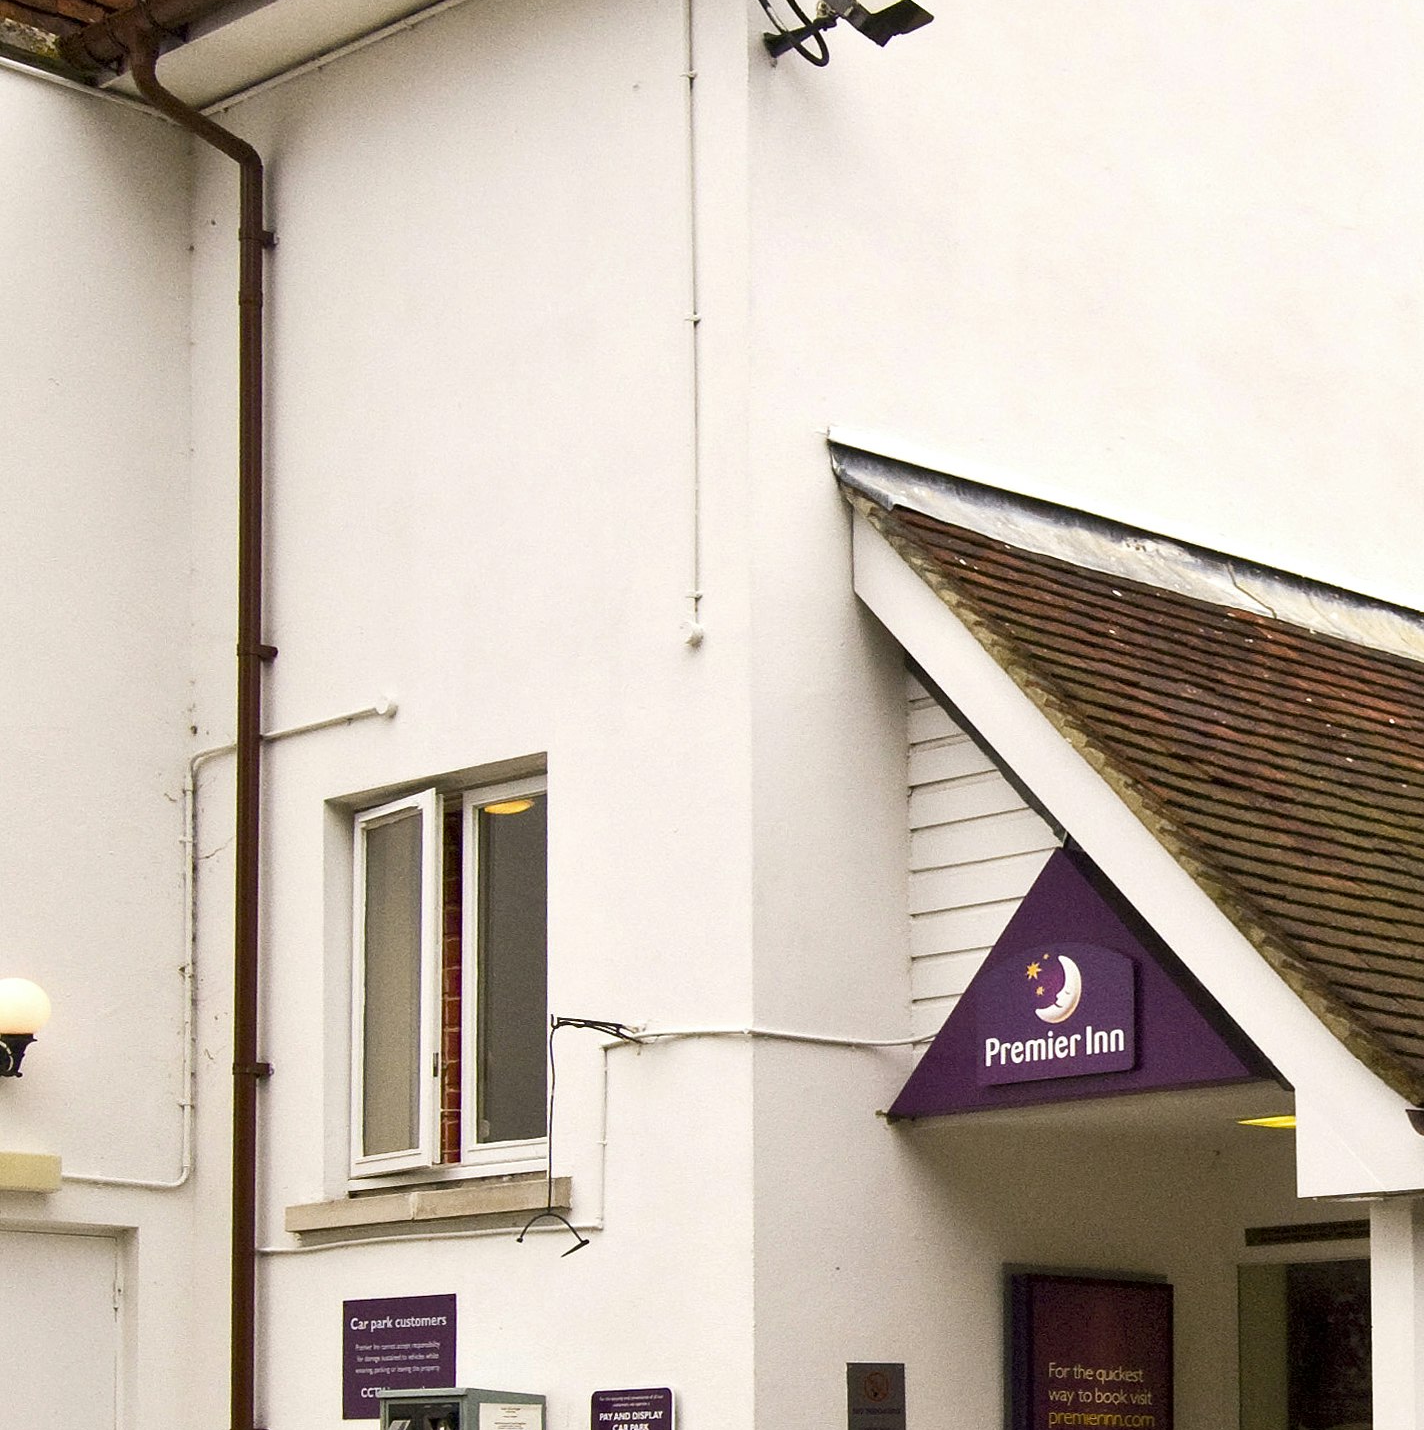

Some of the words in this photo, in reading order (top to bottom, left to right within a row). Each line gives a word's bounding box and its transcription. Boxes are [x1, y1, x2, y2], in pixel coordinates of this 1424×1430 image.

[985, 1030, 1082, 1067] Premier
[1085, 1025, 1125, 1056] Inn
[350, 1317, 369, 1331] Car
[370, 1316, 393, 1333] park
[394, 1316, 448, 1328] customers
[1048, 1362, 1071, 1379] For
[1072, 1364, 1094, 1380] the
[1095, 1366, 1144, 1384] quickest
[360, 1387, 386, 1399] CCT
[1048, 1389, 1075, 1406] way
[1078, 1389, 1093, 1403] to
[1095, 1388, 1128, 1405] book
[1129, 1389, 1153, 1405] visit
[599, 1413, 613, 1422] PAY
[613, 1412, 631, 1421] AND
[632, 1410, 664, 1421] DISPLAY
